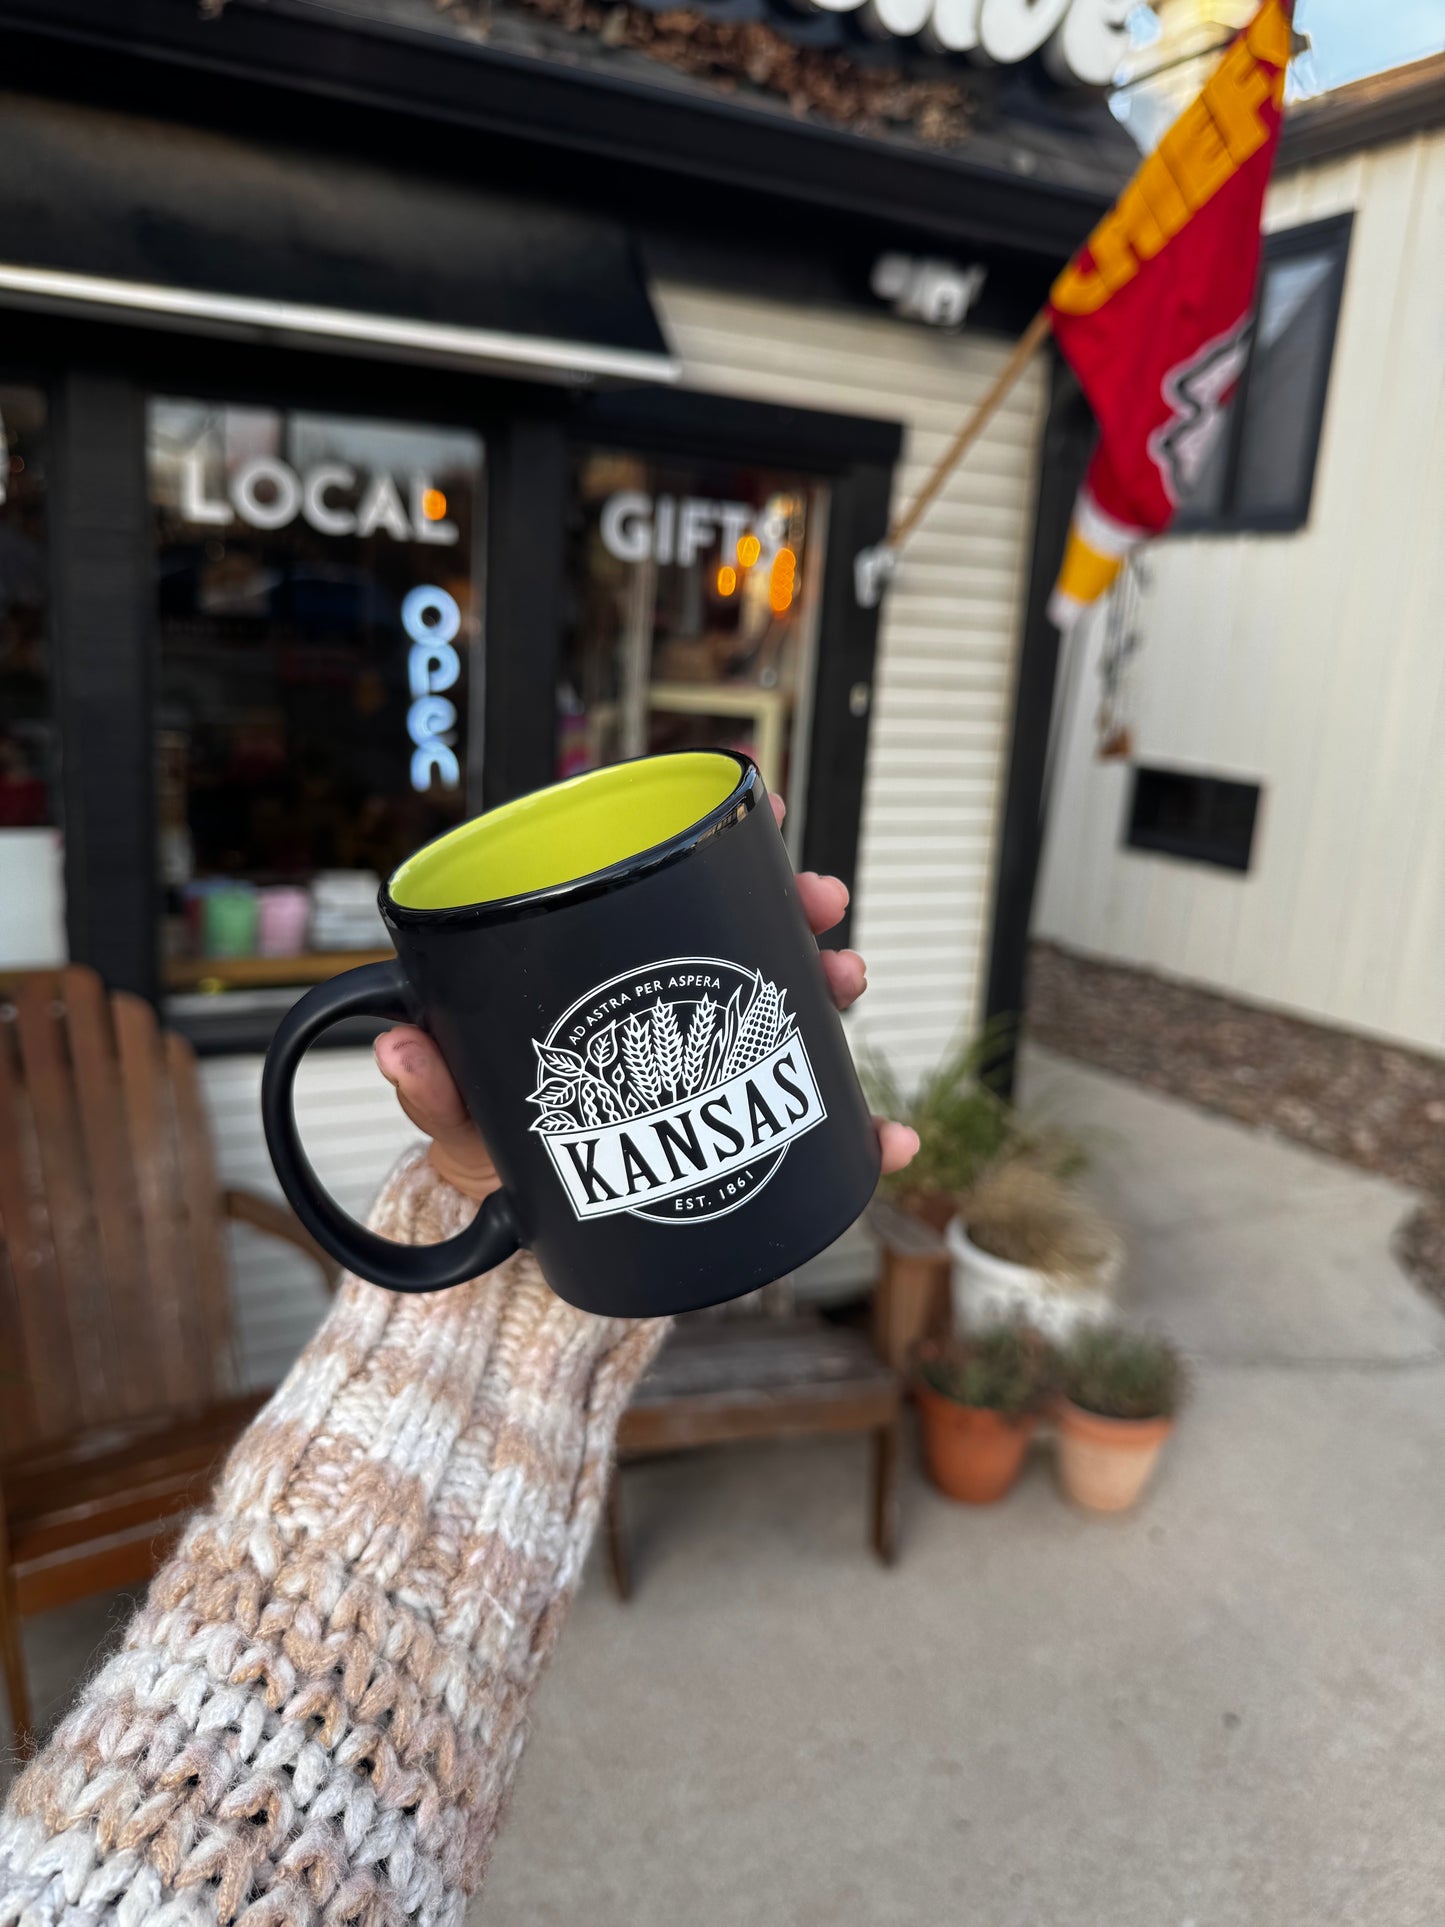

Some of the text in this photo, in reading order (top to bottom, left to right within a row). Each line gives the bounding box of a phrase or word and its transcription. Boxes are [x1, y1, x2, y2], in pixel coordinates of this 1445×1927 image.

[180, 450, 460, 547] LOCAL
[568, 975, 721, 1046] AD ASTRA PER ASPERA
[560, 1052, 810, 1205] KANSAS
[675, 1170, 754, 1211] EST. 1861
